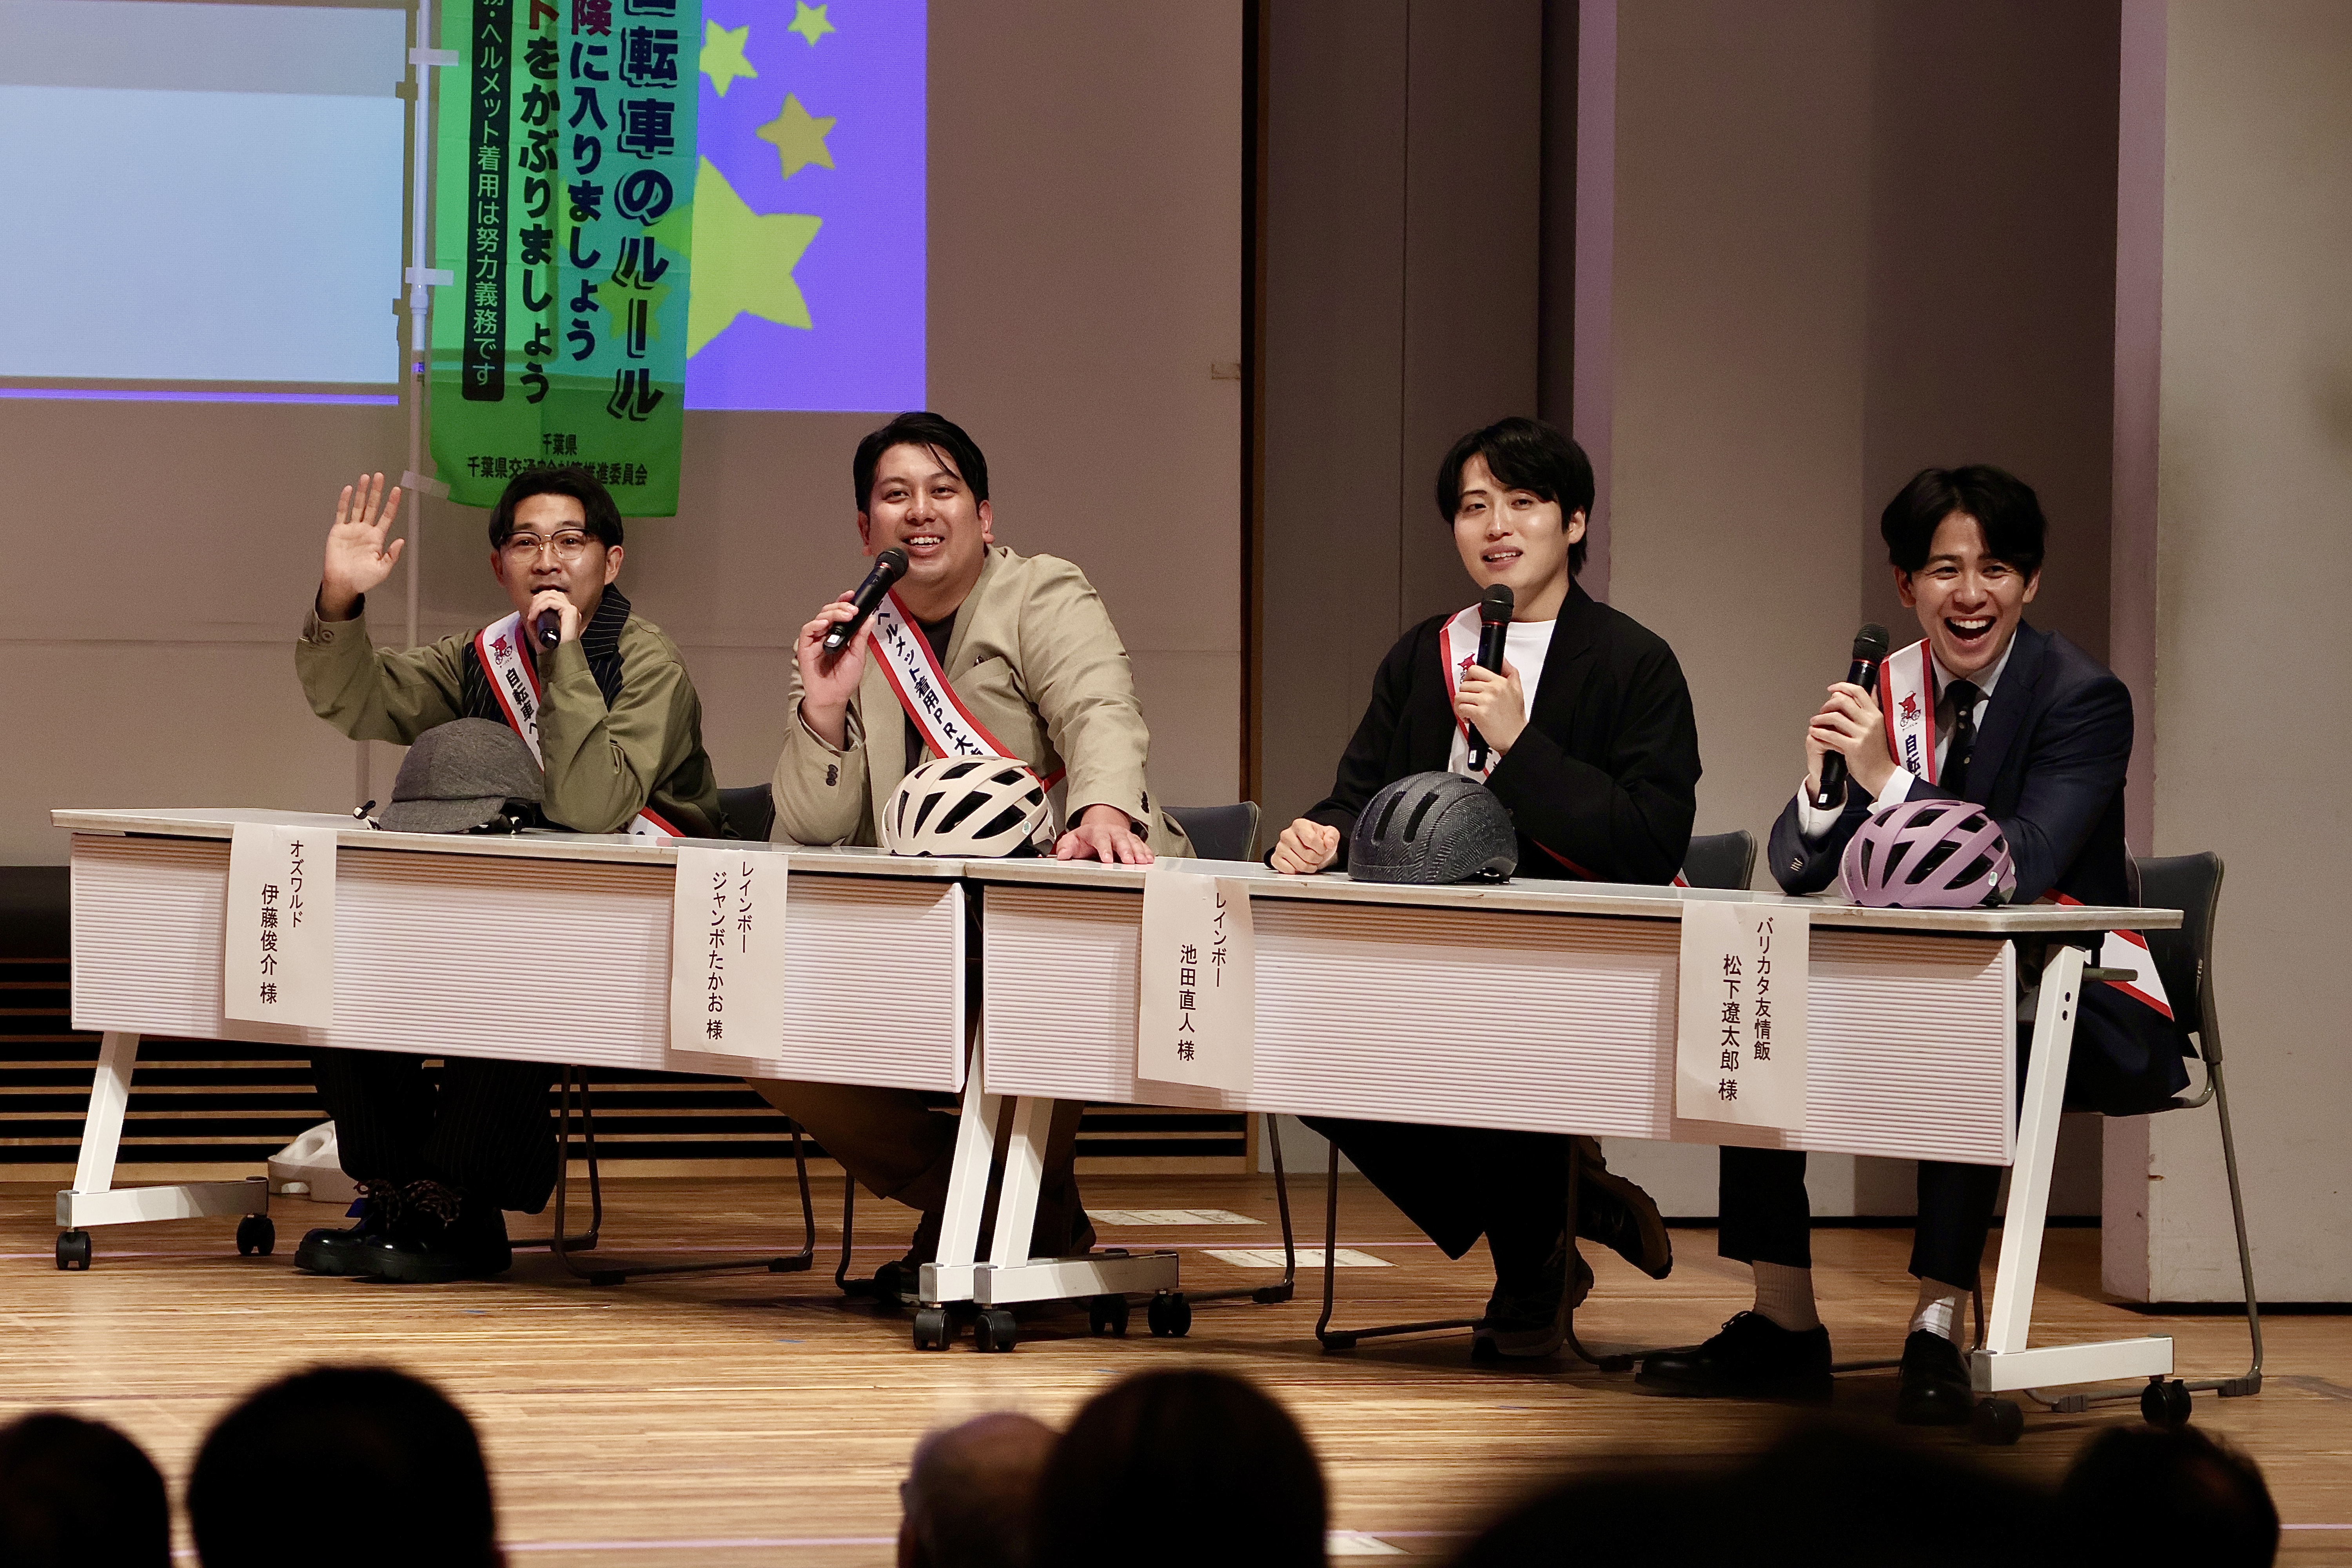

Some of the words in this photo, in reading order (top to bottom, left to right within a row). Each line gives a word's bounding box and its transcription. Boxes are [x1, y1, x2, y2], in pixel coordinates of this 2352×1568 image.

[472, 0, 503, 385] ・ヘルメット着用は努力義務です
[607, 0, 678, 421] 転車のルール
[543, 433, 577, 456] 千葉県
[872, 600, 984, 755] ヘルメット着用PR大
[1905, 734, 1921, 779] 自転
[260, 883, 279, 975] 伊藤俊介
[289, 840, 304, 928] オズワルド
[737, 861, 754, 953] レインボー
[708, 871, 727, 1012] ジャンボたかお
[1211, 892, 1227, 987] レインボー
[260, 982, 277, 1004] 様
[706, 1018, 723, 1040] 様
[1178, 944, 1197, 1033] 池田直人
[1720, 954, 1742, 1072] 松下遼太郎
[1754, 917, 1773, 1061] バリカタ友情飯
[1177, 1039, 1195, 1062] 様
[1718, 1078, 1737, 1101] 様
